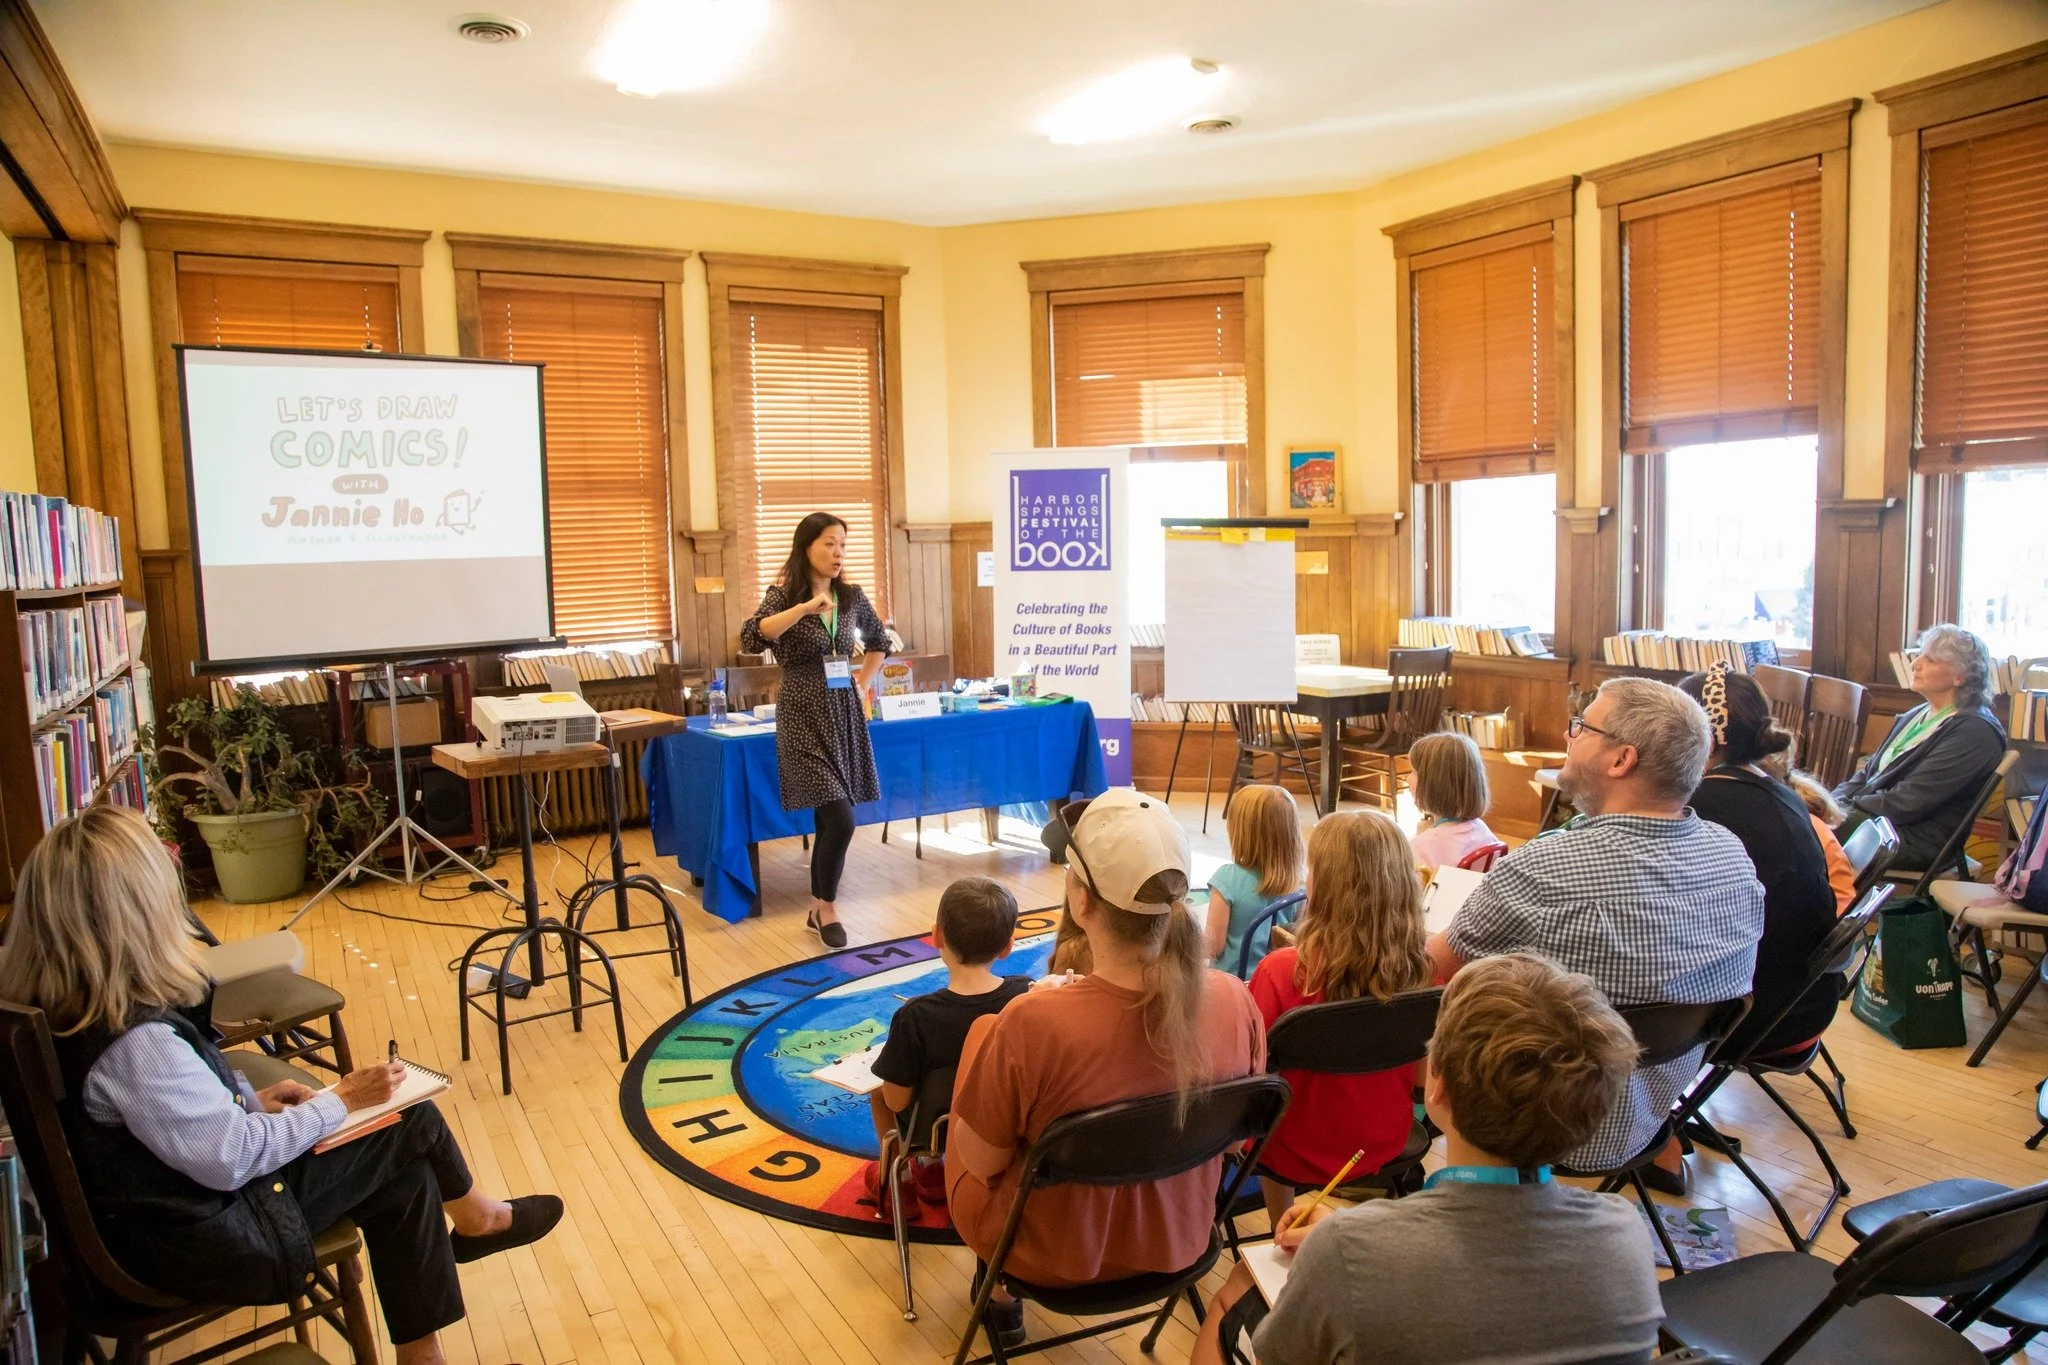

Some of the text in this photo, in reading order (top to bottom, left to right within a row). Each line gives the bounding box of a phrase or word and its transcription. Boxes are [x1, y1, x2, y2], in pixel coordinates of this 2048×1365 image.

[276, 394, 458, 423] LET'S DRAW
[269, 427, 468, 468] COMICS!
[342, 479, 379, 490] WITH
[1020, 494, 1099, 505] HARBOR
[261, 496, 424, 528] Jannie Ho
[1020, 506, 1099, 516] SPRINGS
[1020, 518, 1099, 528] FESTIVAL
[1020, 528, 1099, 539] OF THE
[1016, 602, 1108, 617] Celebrating the
[1013, 623, 1112, 635] Culture of Books
[1008, 643, 1118, 655] in a Beautiful Part
[1042, 664, 1061, 675] the
[1064, 664, 1099, 676] World
[898, 697, 926, 708] Jannie
[764, 1027, 874, 1057] AUSTRALIA
[658, 917, 1056, 1182] G H I J K L M O
[796, 1093, 854, 1112] CEAN
[801, 1097, 872, 1122] ACIFIC
